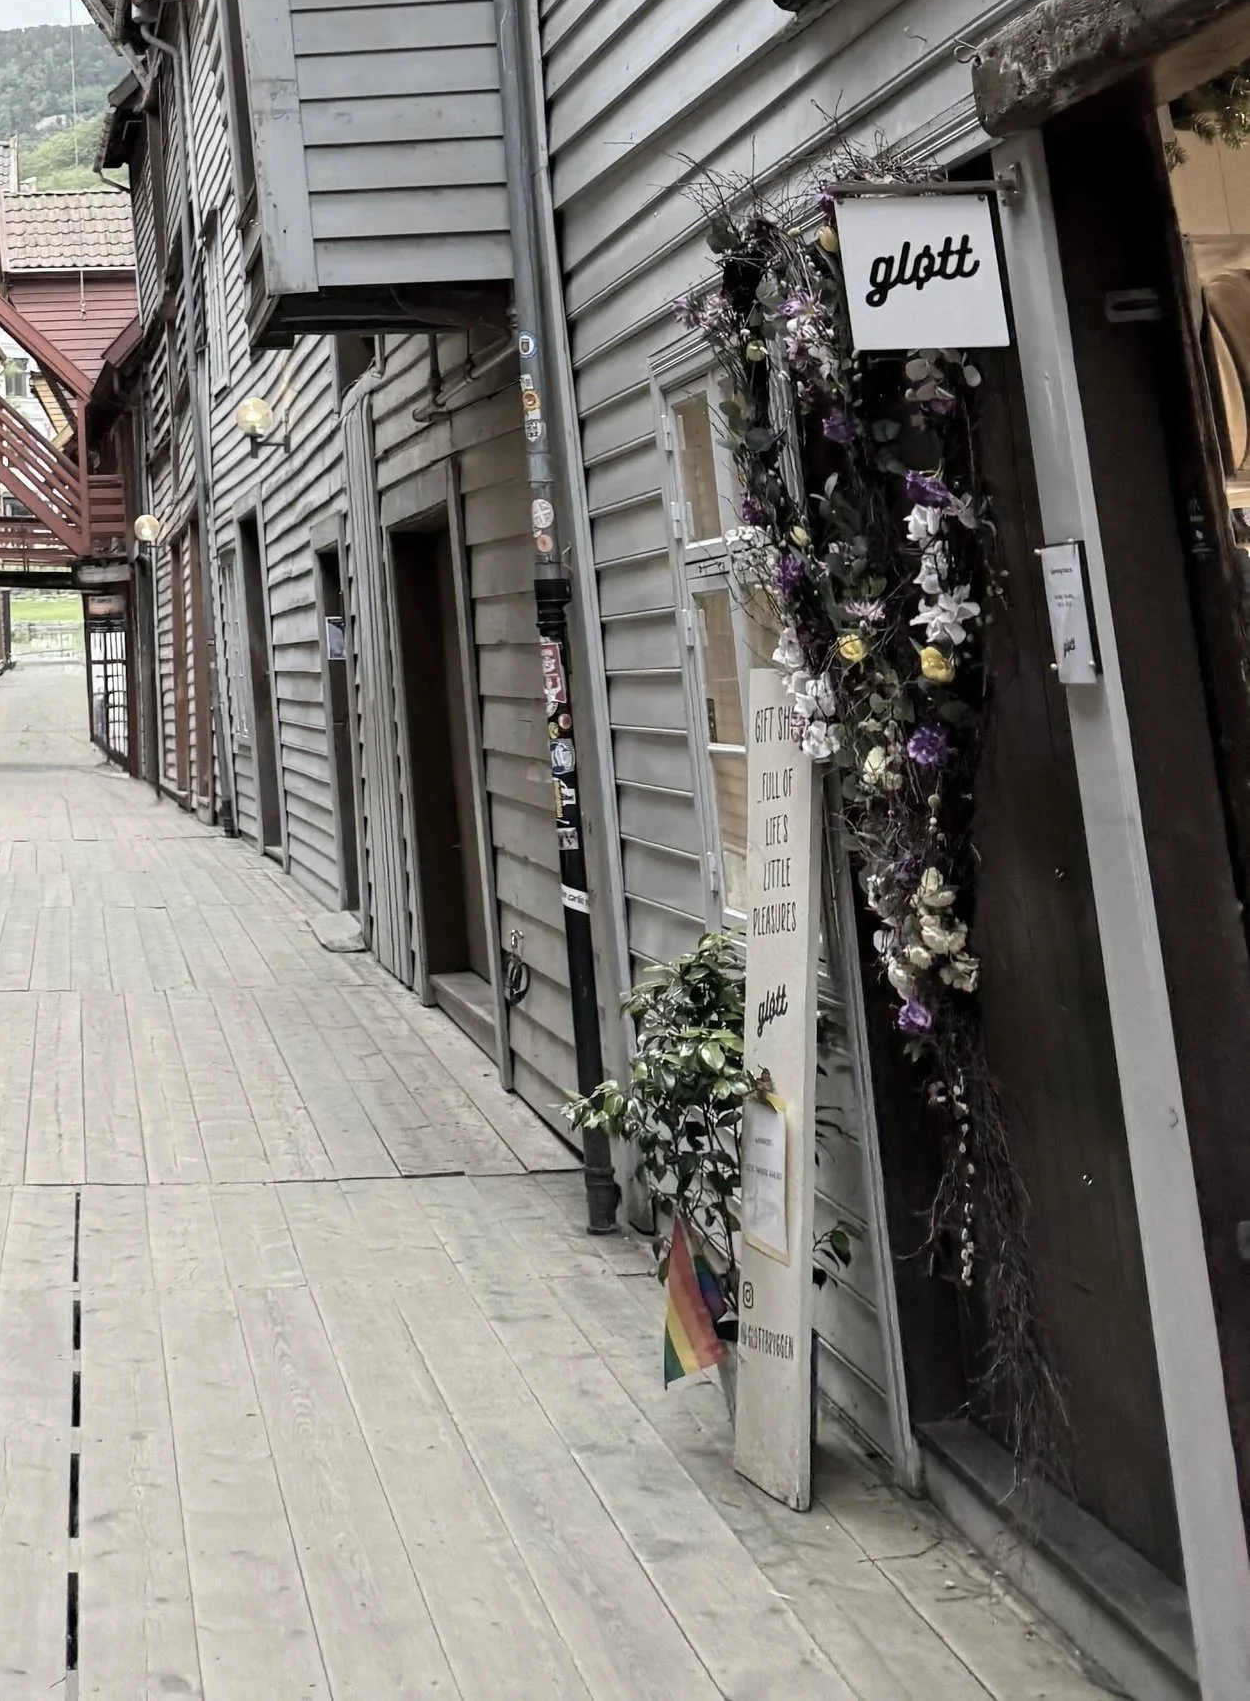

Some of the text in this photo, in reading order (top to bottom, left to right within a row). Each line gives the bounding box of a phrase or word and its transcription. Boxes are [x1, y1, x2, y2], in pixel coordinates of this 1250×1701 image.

[865, 234, 980, 307] gløtt
[755, 707, 775, 743] GIFT
[782, 768, 793, 798] OF
[763, 857, 792, 891] LITTLE
[753, 901, 797, 936] PLEASURES
[757, 984, 788, 1037] gløtt
